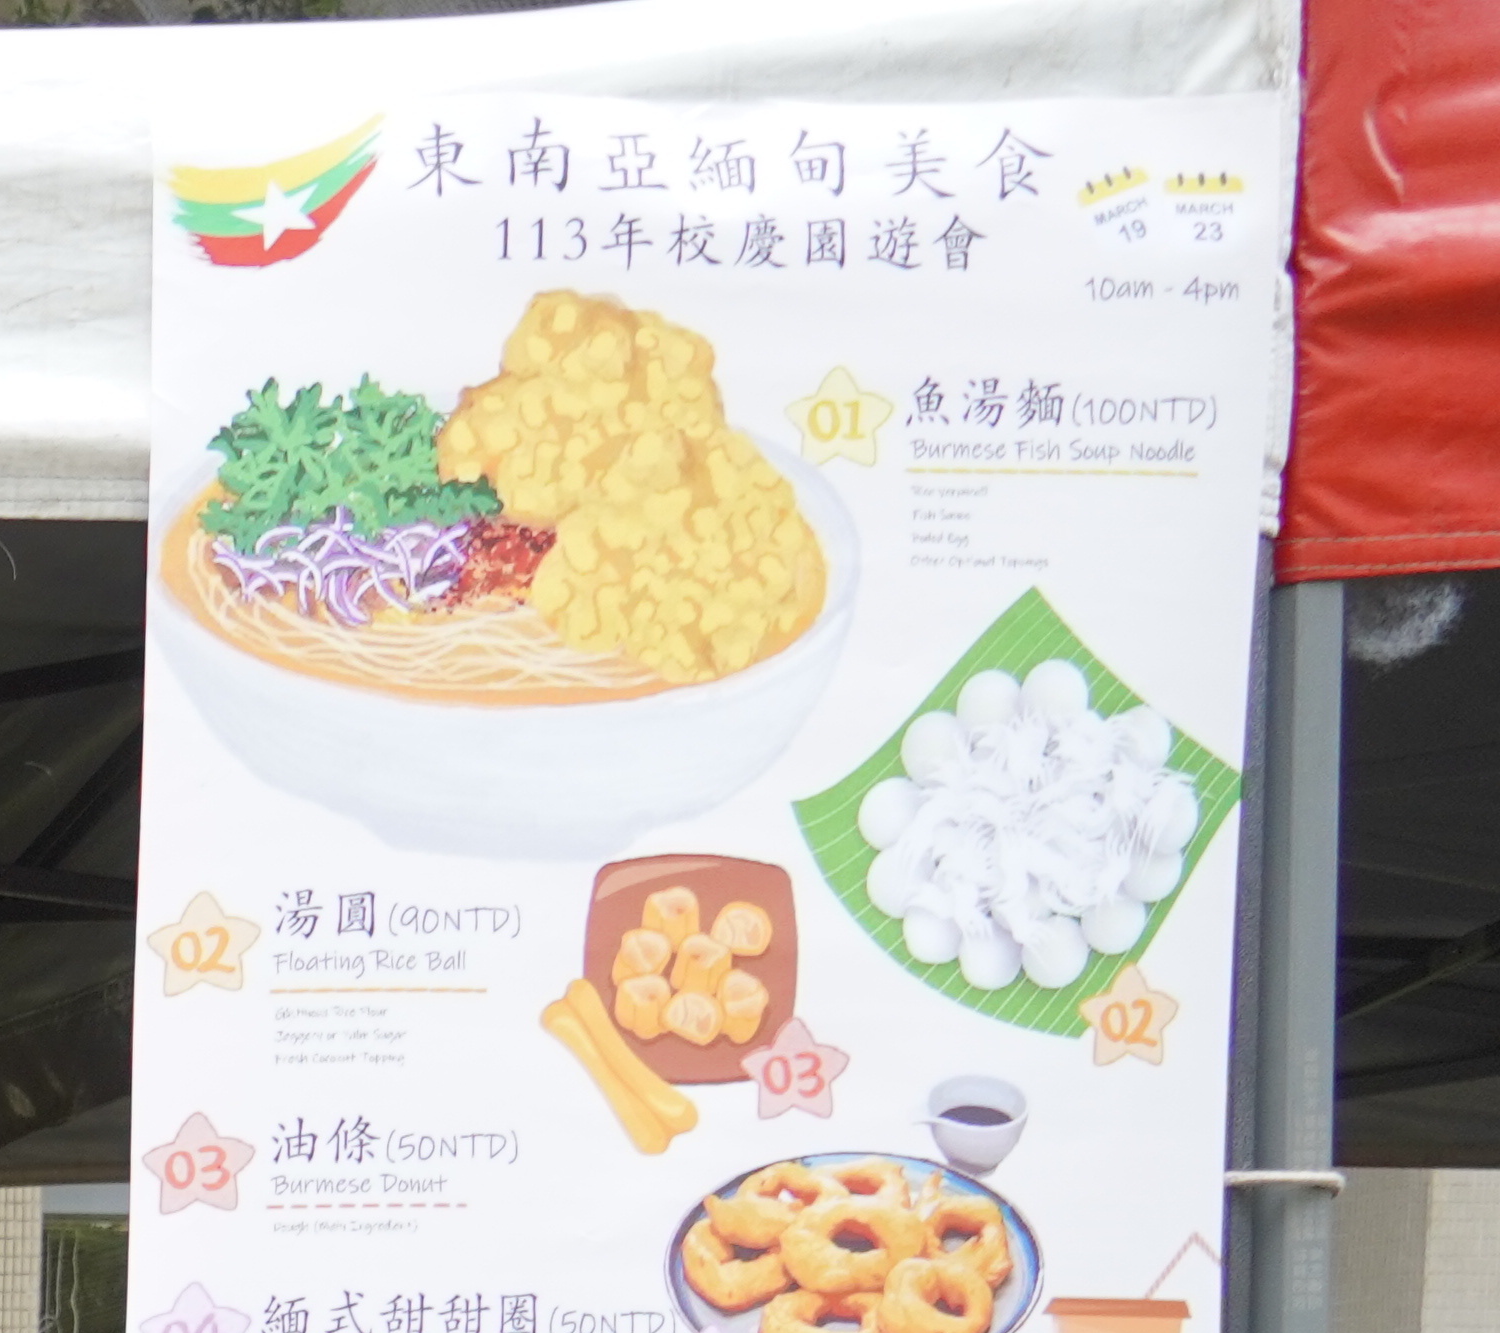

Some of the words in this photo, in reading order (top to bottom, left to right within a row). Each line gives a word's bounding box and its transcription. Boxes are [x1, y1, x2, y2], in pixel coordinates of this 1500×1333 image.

[407, 117, 1054, 200] 東南亞緬甸美食
[1093, 197, 1149, 225] MARCH
[1175, 202, 1234, 215] MARCH
[495, 212, 987, 272] 113年校慶園遊會
[1119, 220, 1147, 243] 19
[1193, 220, 1224, 243] 23
[1084, 278, 1155, 301] 10am
[1183, 277, 1240, 305] 4pm
[807, 399, 866, 442] 01
[905, 376, 1064, 428] 魚湯麵
[1071, 395, 1218, 431] (100NTD)
[912, 438, 1006, 461] Burmese
[1014, 438, 1060, 462] Fish
[1069, 438, 1120, 464] Soup
[1129, 440, 1196, 462] Noodle
[275, 888, 376, 939] 湯圓
[388, 901, 522, 938] (90NTD)
[171, 926, 235, 973] 02
[273, 950, 366, 979] Floating
[372, 950, 417, 971] Rice
[425, 950, 467, 971] Ball
[1100, 1005, 1158, 1046] 02
[763, 1052, 824, 1096] 03
[271, 1115, 381, 1164] 油條
[385, 1130, 519, 1165] (50NTD)
[165, 1145, 231, 1191] 03
[272, 1174, 371, 1196] Burmese
[380, 1174, 448, 1194] Donut
